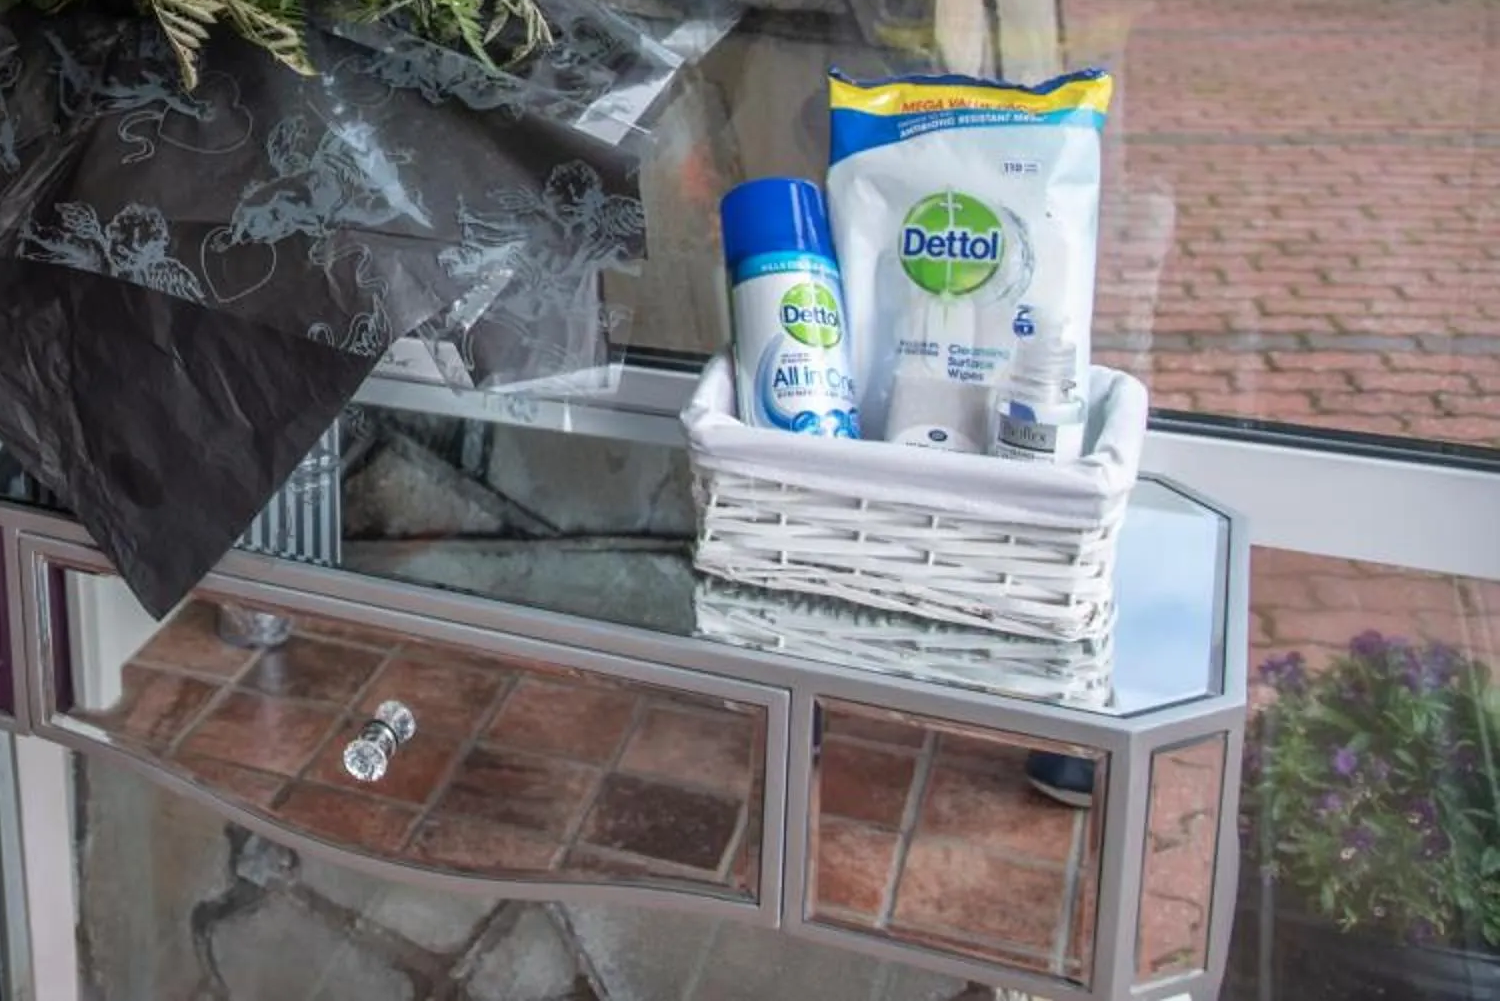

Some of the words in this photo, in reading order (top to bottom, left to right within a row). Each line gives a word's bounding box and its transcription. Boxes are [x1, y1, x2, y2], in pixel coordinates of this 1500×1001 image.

[903, 228, 999, 260] Dettol
[947, 357, 994, 370] Surface
[772, 365, 799, 388] All
[803, 365, 822, 387] in
[947, 369, 985, 382] Wipes
